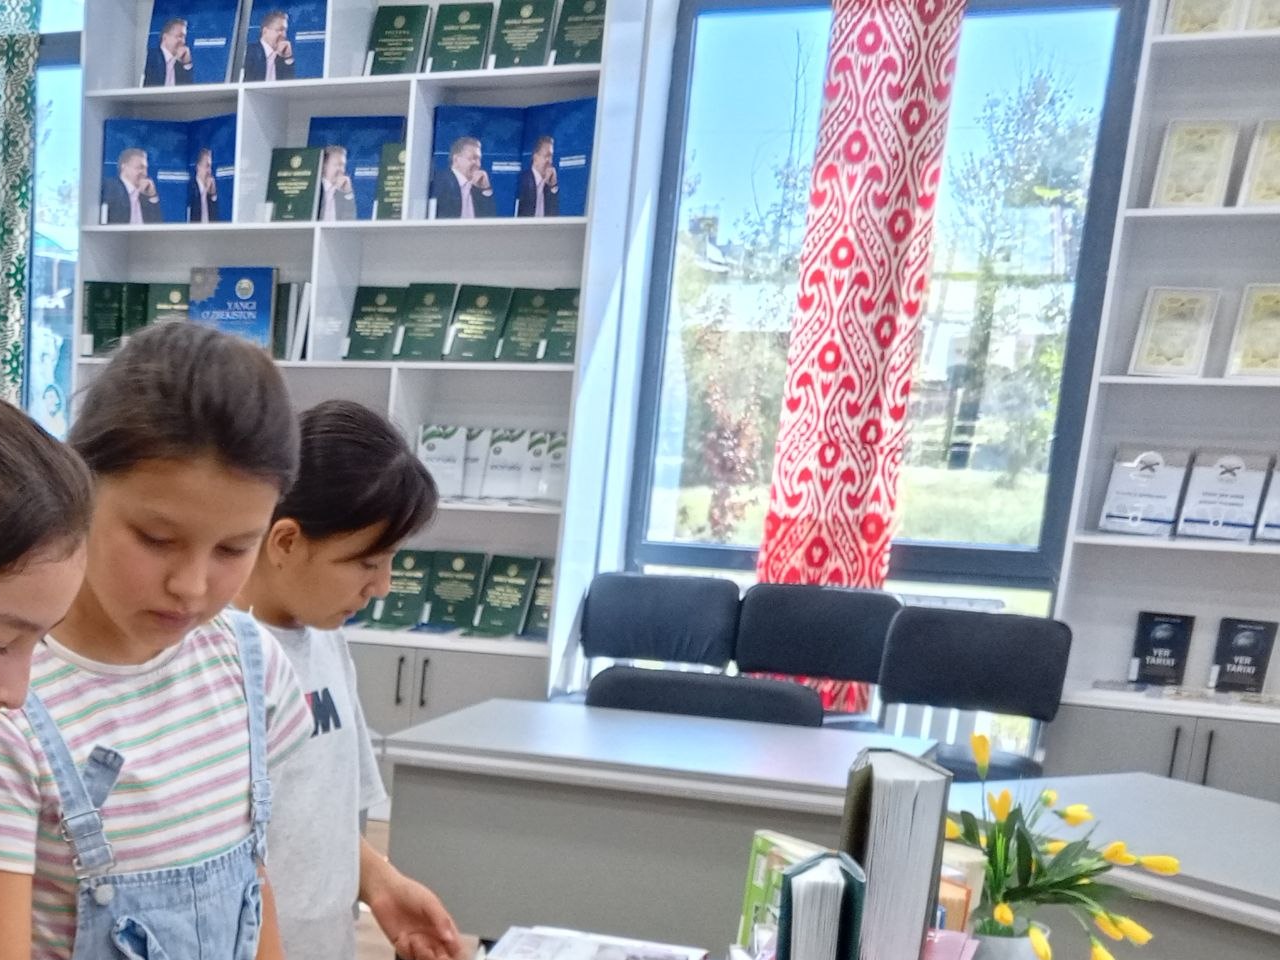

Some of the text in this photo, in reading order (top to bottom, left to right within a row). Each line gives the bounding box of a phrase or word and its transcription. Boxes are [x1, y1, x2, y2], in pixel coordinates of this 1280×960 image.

[226, 301, 257, 311] YANGI
[1152, 648, 1171, 657] YER
[1233, 656, 1252, 664] YER
